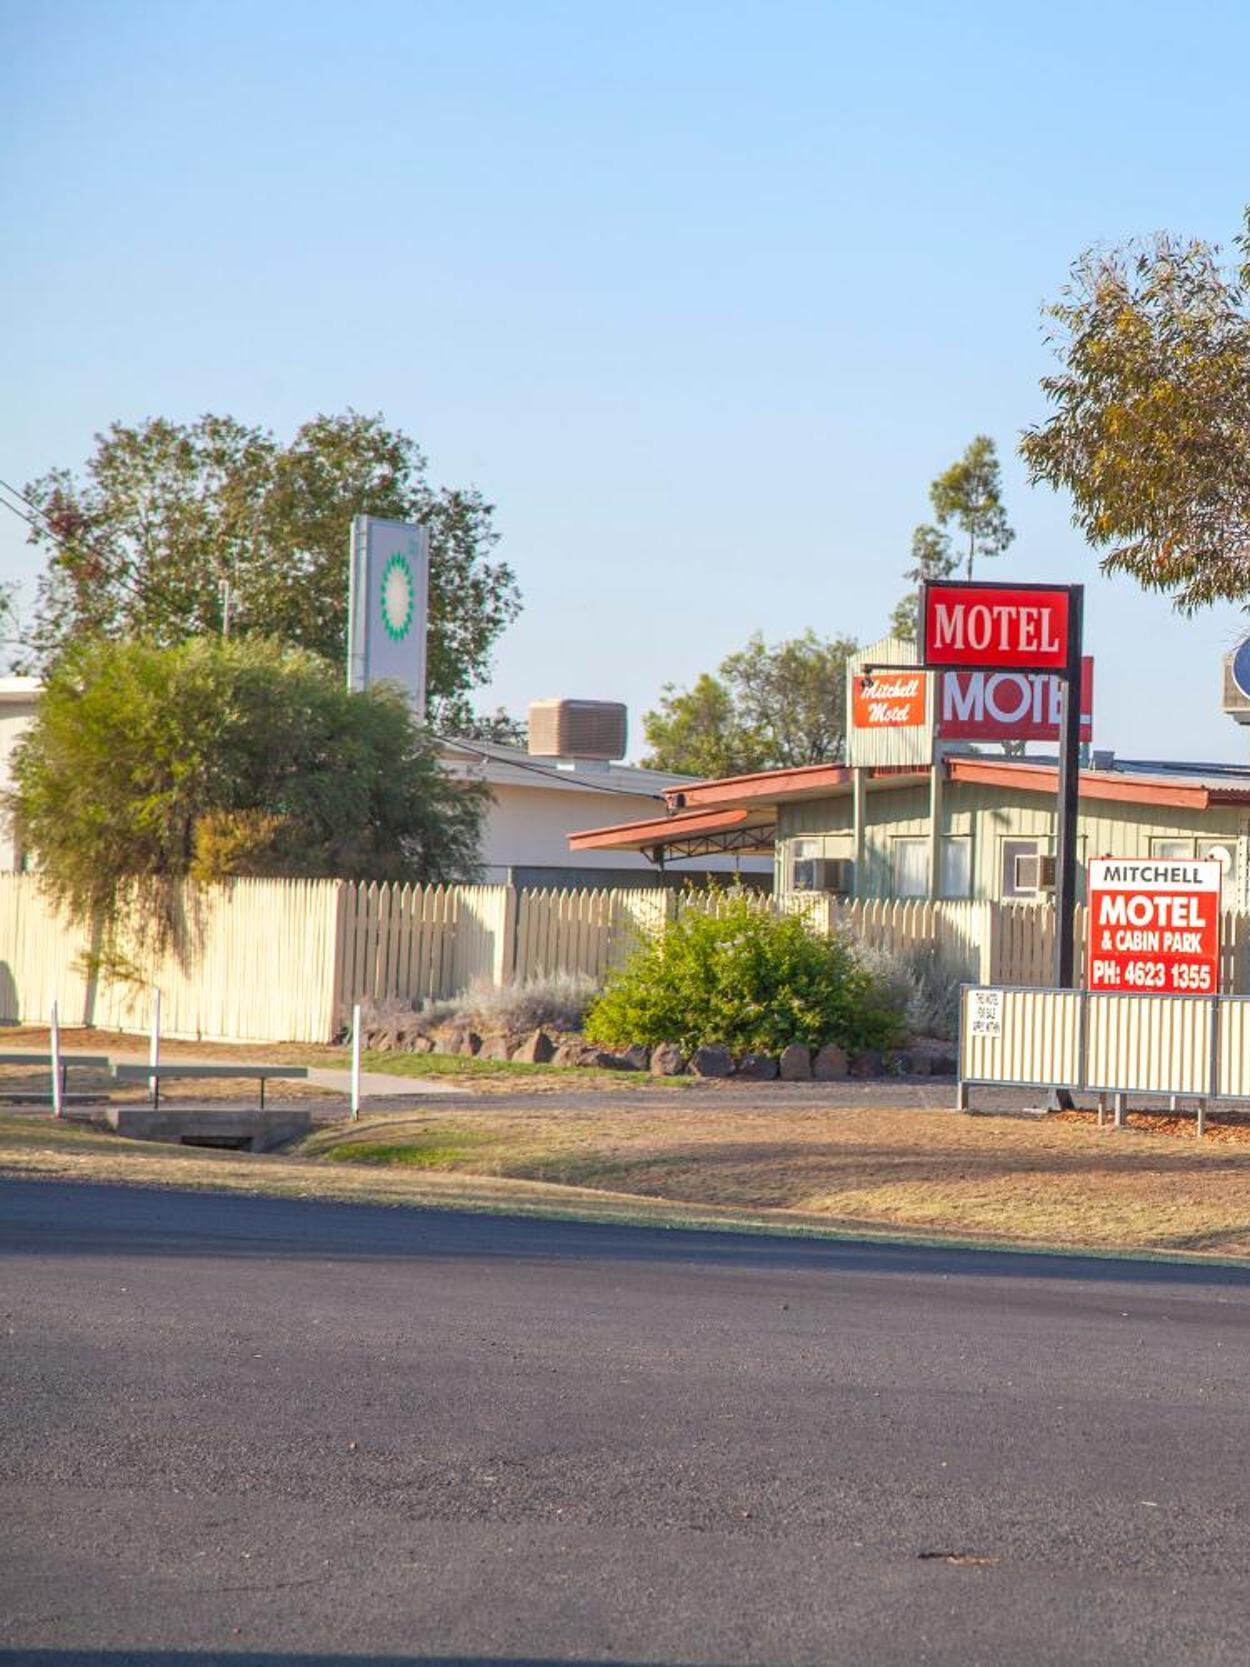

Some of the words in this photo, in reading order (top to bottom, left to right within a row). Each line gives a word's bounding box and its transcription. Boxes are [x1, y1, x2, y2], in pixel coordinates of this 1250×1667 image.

[933, 603, 1060, 653] MOTEL
[861, 679, 919, 699] Mitchell
[943, 671, 1092, 724] MOTE
[868, 703, 911, 722] Motel
[1103, 866, 1203, 884] MITCHELL
[1099, 895, 1206, 928] MOTEL
[1101, 930, 1112, 951] &
[1116, 930, 1159, 952] CABIN
[1163, 931, 1202, 953] PARK
[1093, 960, 1120, 984] PH:
[1125, 961, 1165, 986] 4623
[1171, 963, 1211, 989] 1355
